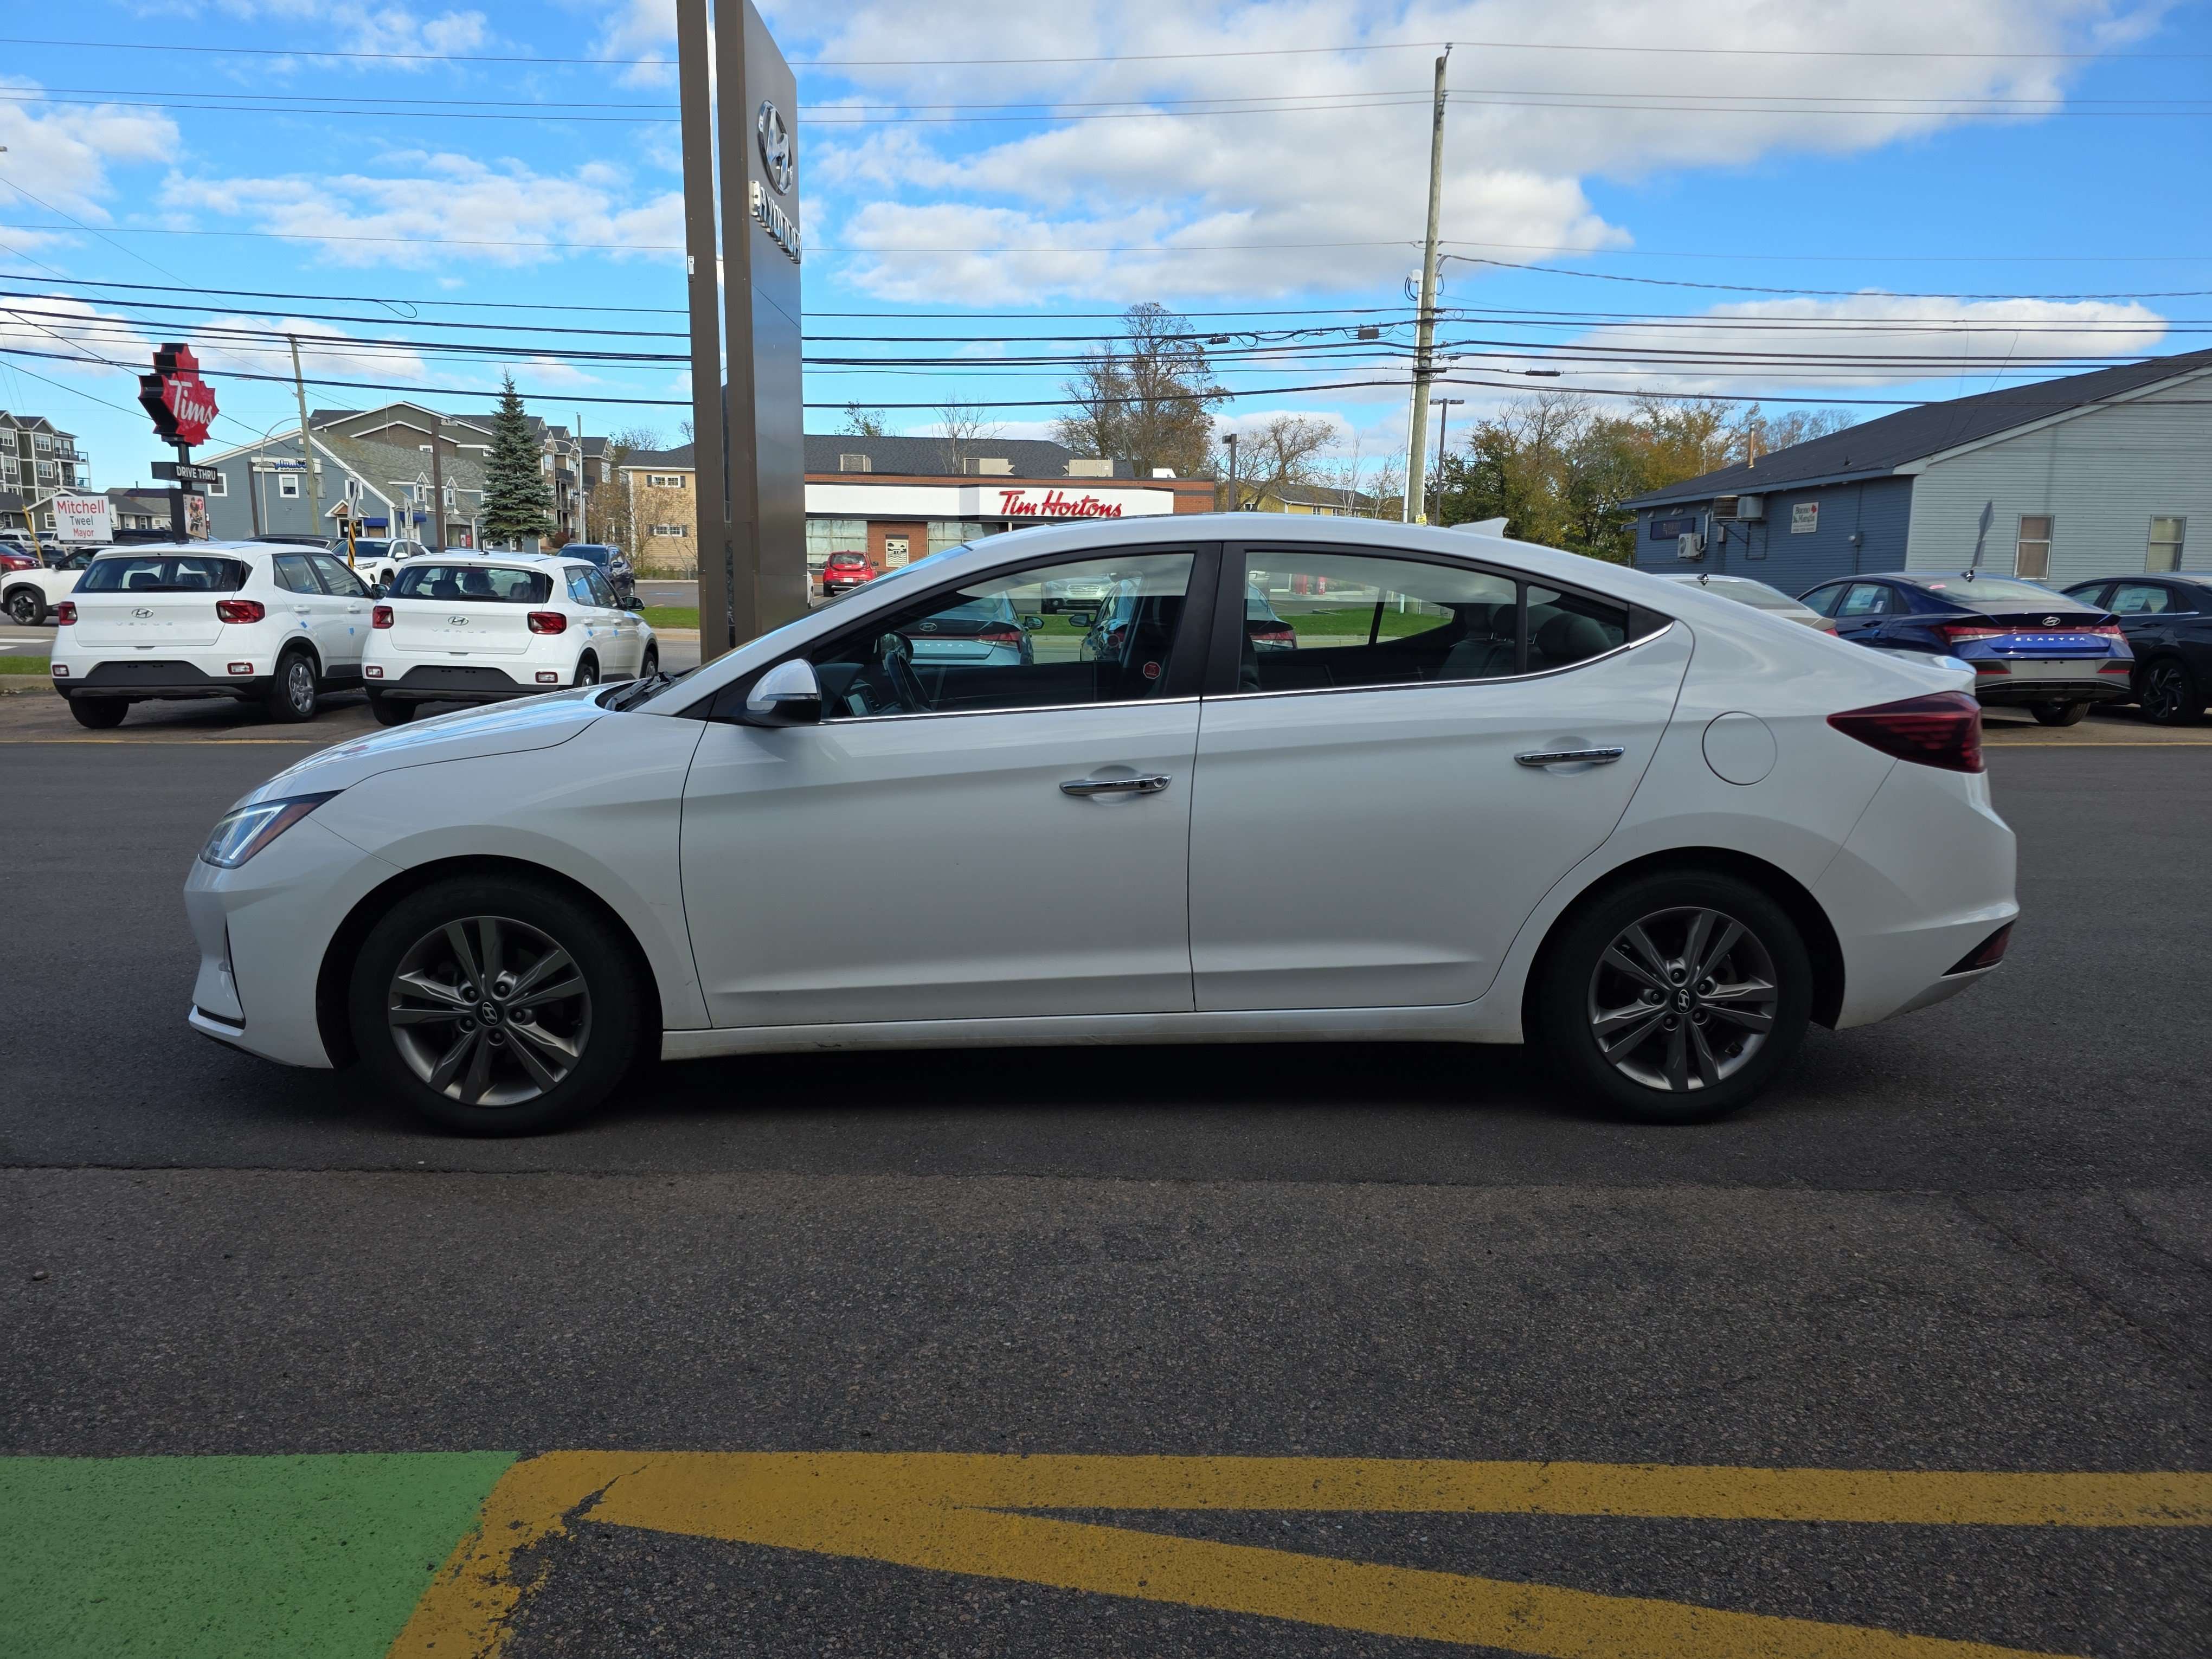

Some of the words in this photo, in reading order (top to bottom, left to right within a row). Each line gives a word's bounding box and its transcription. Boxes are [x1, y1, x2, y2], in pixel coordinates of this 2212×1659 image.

[168, 380, 213, 425] Tims
[176, 465, 197, 479] DRIVE
[197, 468, 216, 481] THRU
[57, 499, 105, 515] Mitchell
[999, 490, 1038, 516] Tim
[1040, 490, 1122, 517] Hortons
[69, 515, 94, 525] Tweel
[73, 528, 94, 538] Mayor
